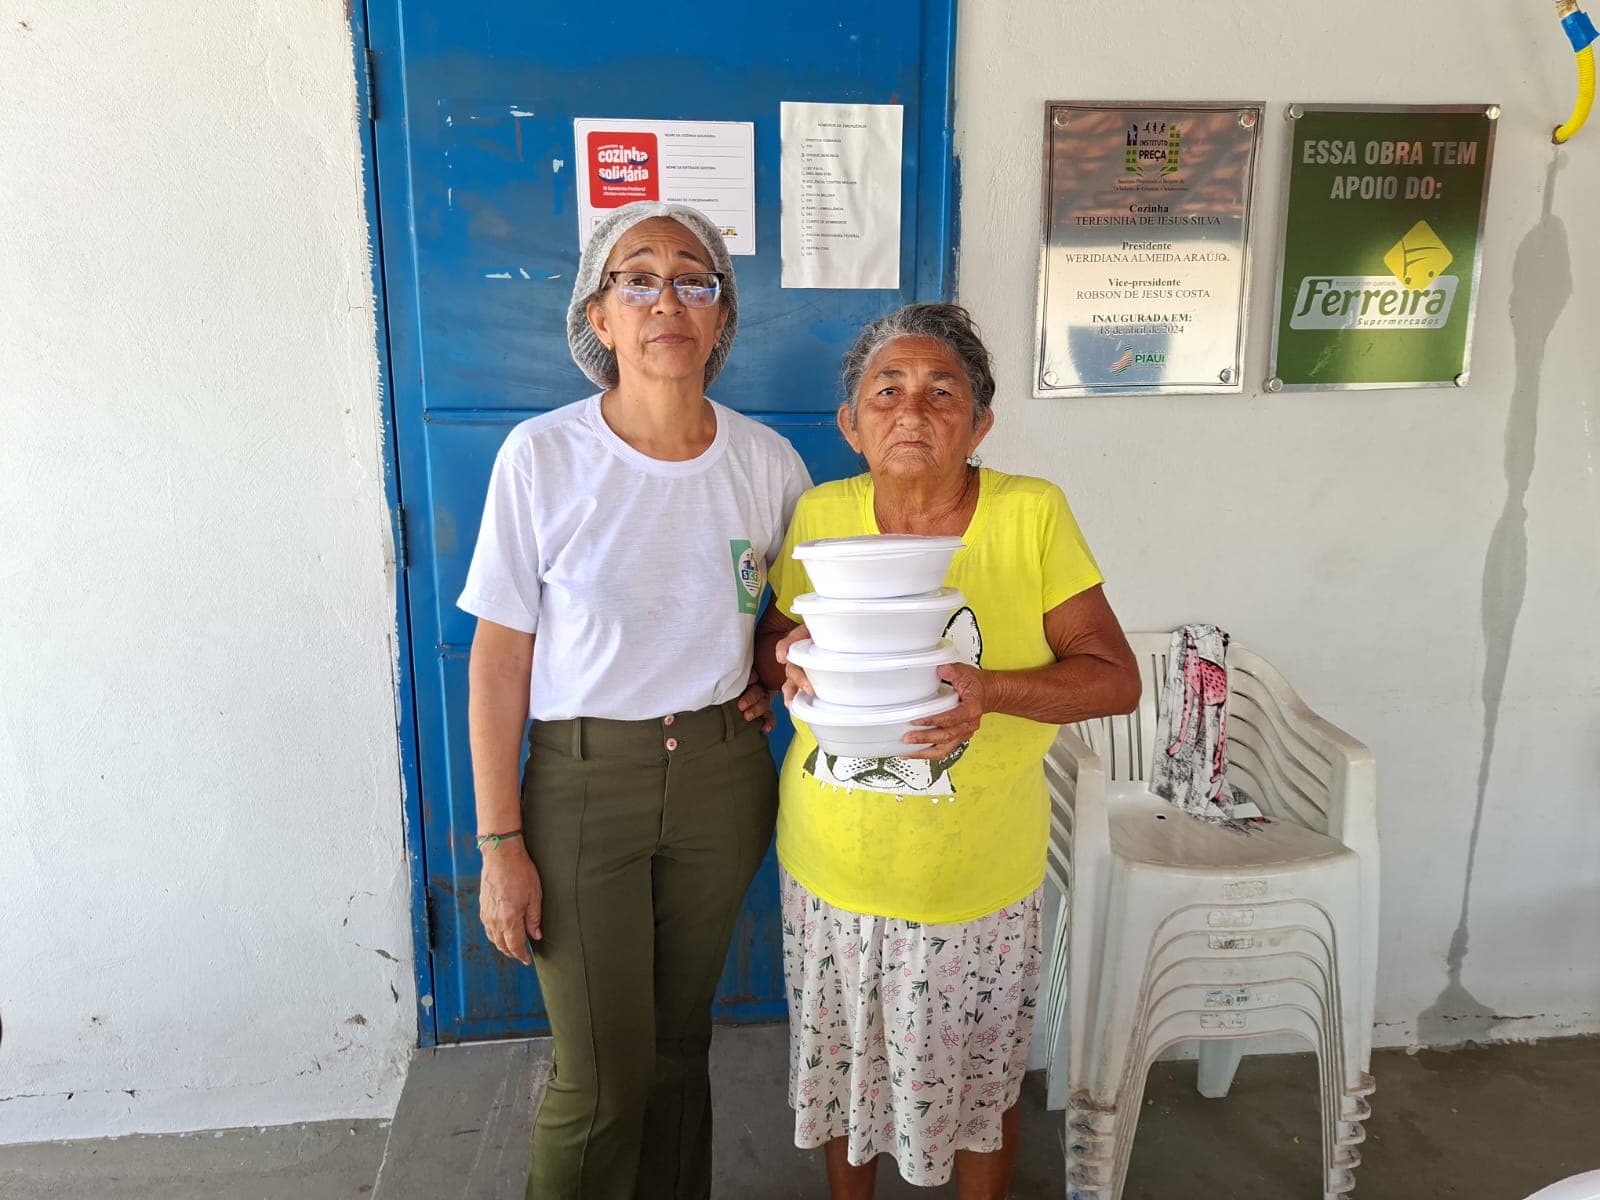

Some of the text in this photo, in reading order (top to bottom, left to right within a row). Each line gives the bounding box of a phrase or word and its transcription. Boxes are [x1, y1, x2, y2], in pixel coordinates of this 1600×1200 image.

[1138, 139, 1168, 147] INSTITUTO
[598, 145, 648, 163] cozinha
[1138, 150, 1167, 162] PREÇA
[1303, 140, 1479, 165] ESSA OBRA TEM
[598, 165, 649, 182] solidária
[1330, 176, 1443, 199] APOIO DO:
[1129, 204, 1169, 213] Cozinha
[1075, 216, 1137, 226] TERESINHA
[1139, 216, 1152, 226] DE
[1122, 241, 1172, 250] Presidente
[1065, 254, 1129, 263] WERIDIANA
[1130, 254, 1183, 263] ALMEIDA
[1108, 278, 1182, 289] Vice-presidente
[1076, 289, 1211, 300] ROBSON DE JESUS COSTA
[1297, 279, 1446, 317] Ferreira
[1092, 313, 1192, 324] INAUGURADA EM:
[1357, 318, 1439, 327] Supermercados
[1112, 325, 1122, 335] de
[1125, 324, 1146, 335] abril
[1162, 324, 1184, 334] 2024
